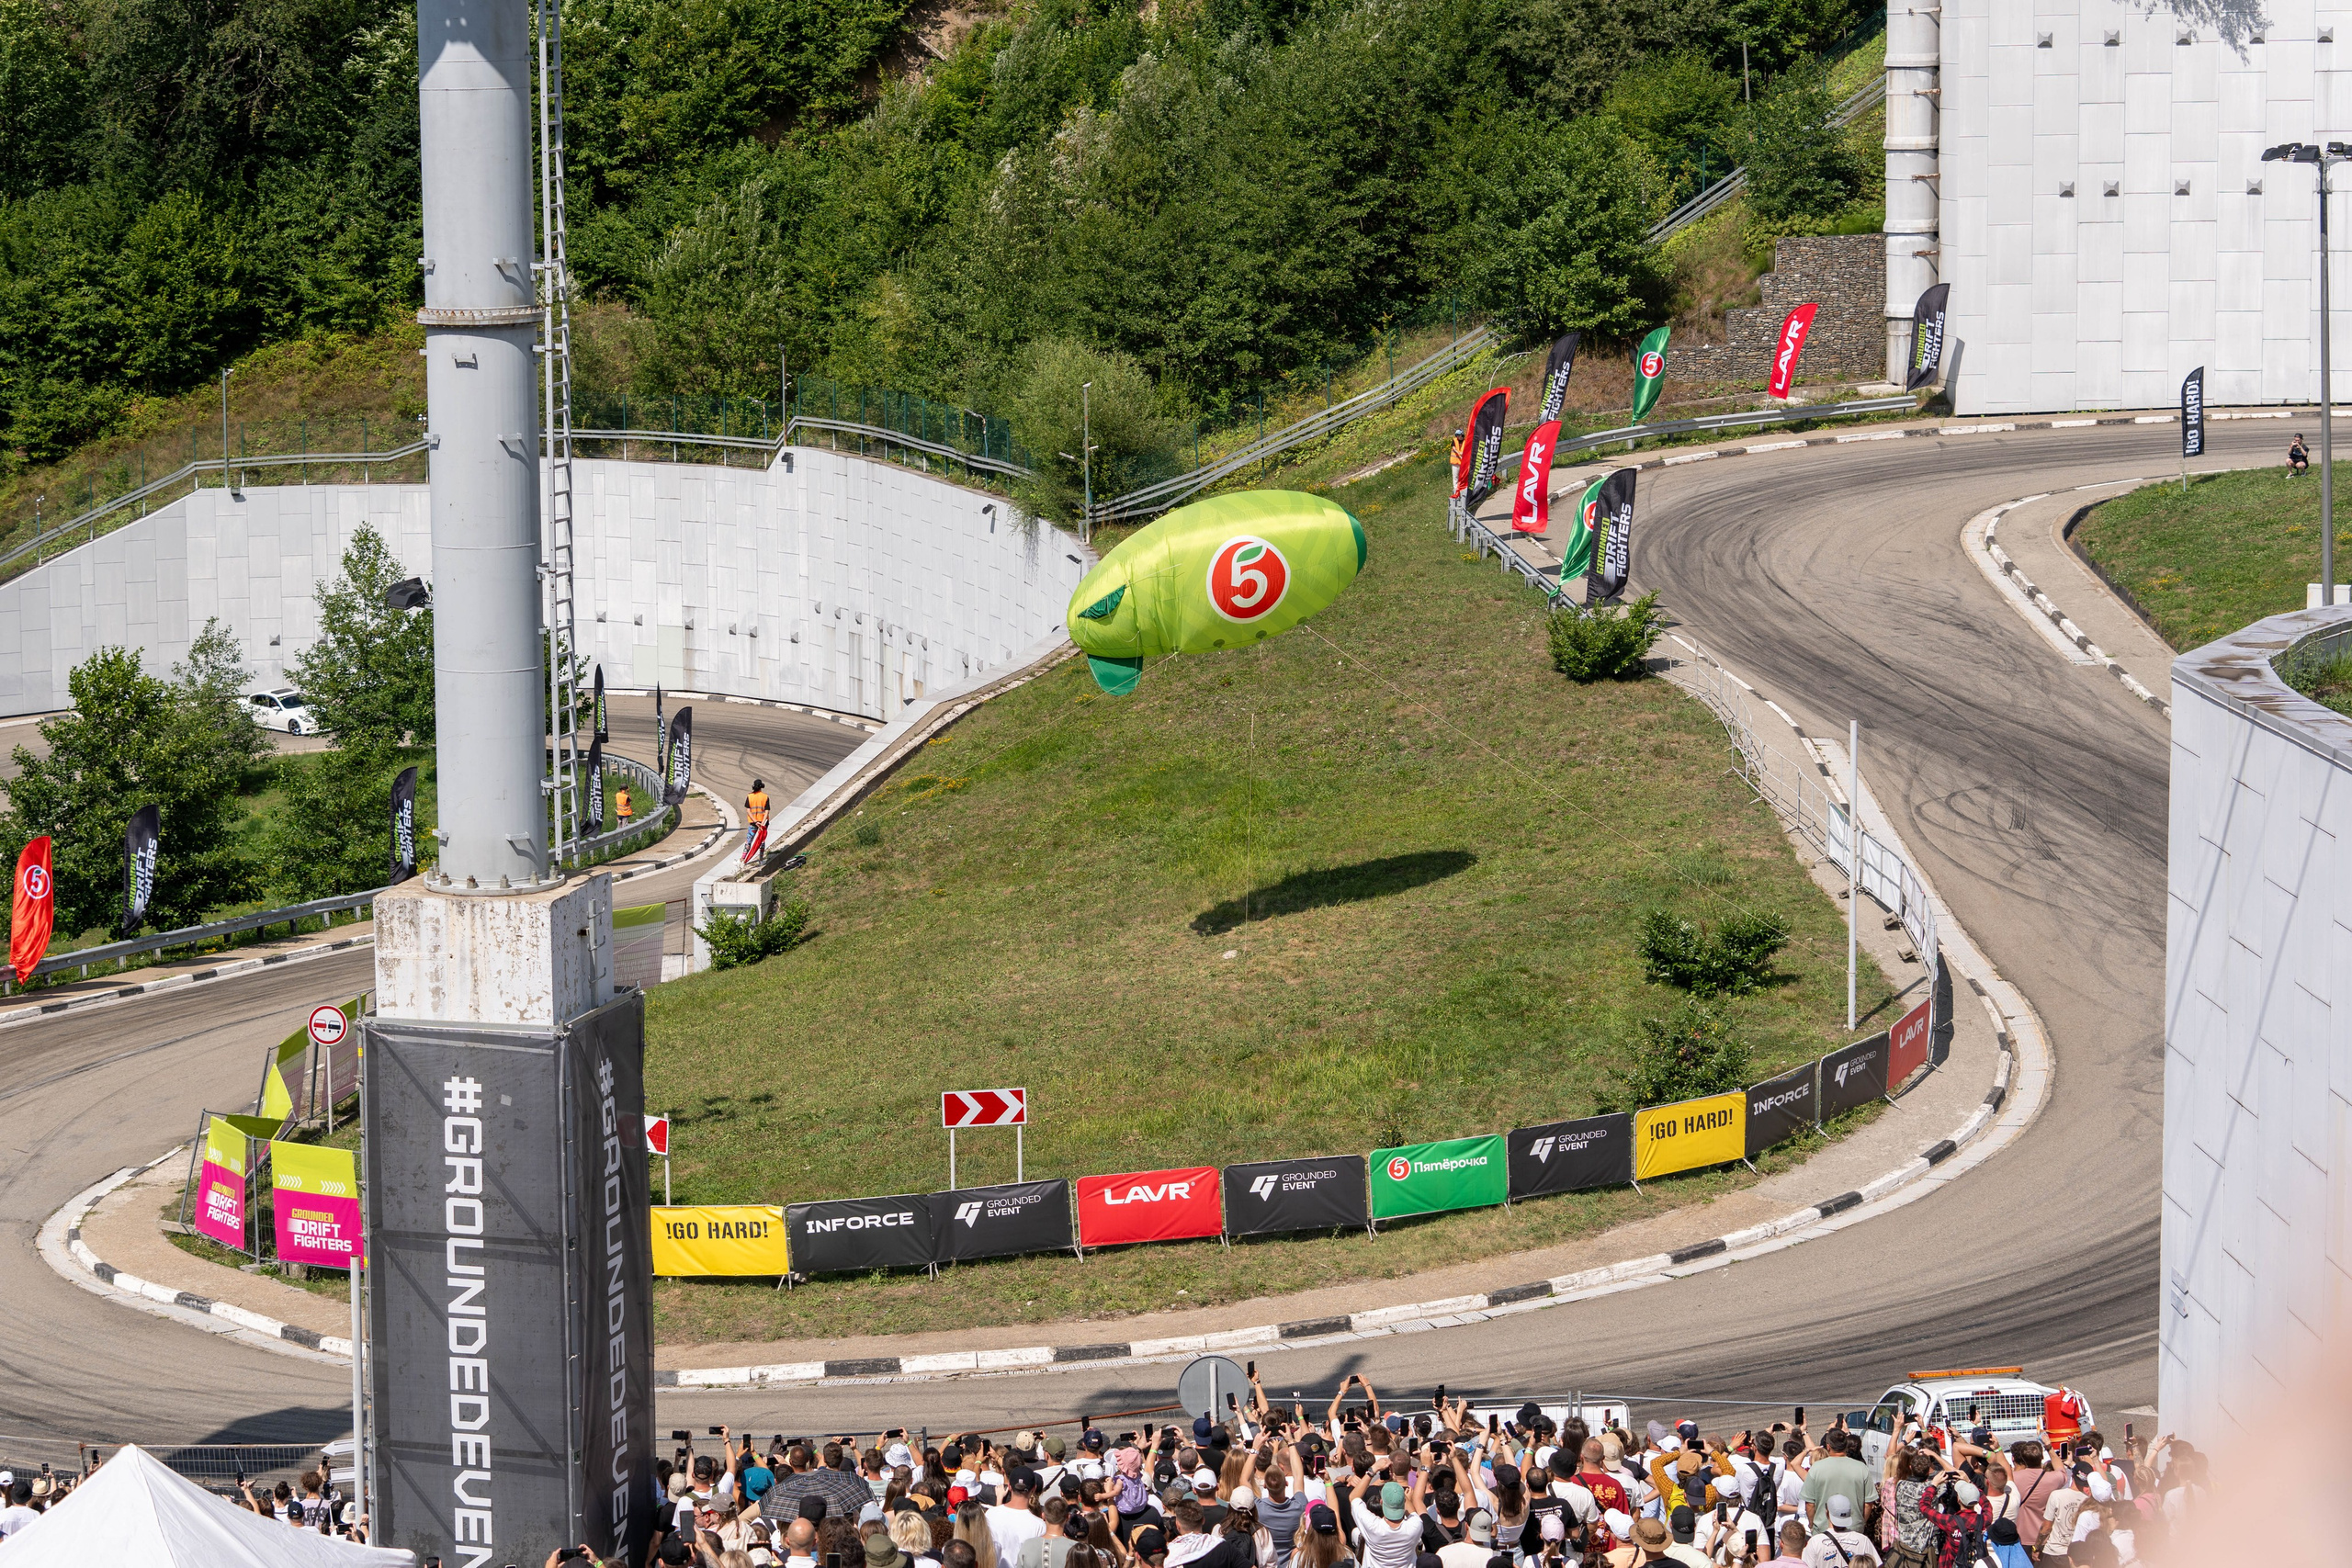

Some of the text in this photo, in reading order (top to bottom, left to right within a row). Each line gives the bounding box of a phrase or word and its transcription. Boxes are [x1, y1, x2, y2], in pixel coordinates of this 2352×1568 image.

[1922, 318, 1935, 366] DRIFT
[1929, 310, 1945, 369] FIGHTERS
[1645, 354, 1658, 374] 5
[1548, 360, 1570, 421] FIGHTERS
[2186, 379, 2199, 425] HARD!
[1483, 426, 1501, 488] FIGHTERS
[1596, 516, 1611, 576] GROUNDED
[1604, 512, 1619, 571] DRIFT
[1616, 502, 1632, 578] FIGHTERS
[1230, 542, 1268, 608] 5
[673, 739, 684, 783] DRIFT
[682, 732, 690, 788] FIGHTERS
[593, 764, 604, 822] FIGHTERS
[134, 847, 146, 908] DRIFT
[1849, 1050, 1877, 1067] GROUNDED
[1849, 1062, 1866, 1076] EVENT
[1753, 1082, 1810, 1116] INFORCE
[1558, 1129, 1607, 1145] GROUNDED
[1649, 1108, 1734, 1142] !GO HARD!
[1558, 1140, 1589, 1152] EVENT
[1282, 1169, 1337, 1182] GROUNDED
[1414, 1156, 1487, 1173] Пятёрочка
[1283, 1179, 1316, 1191] EVENT
[211, 1191, 238, 1214] DRIFT
[986, 1193, 1042, 1210] GROUNDED
[987, 1205, 1021, 1218] EVENT
[207, 1206, 241, 1230] FIGHTERS
[291, 1208, 334, 1224] GROUNDED
[806, 1211, 914, 1235] INFORCE
[298, 1219, 341, 1238] DRIFT
[666, 1220, 768, 1241] !GO HARD!
[294, 1234, 353, 1252] FIGHTERS
